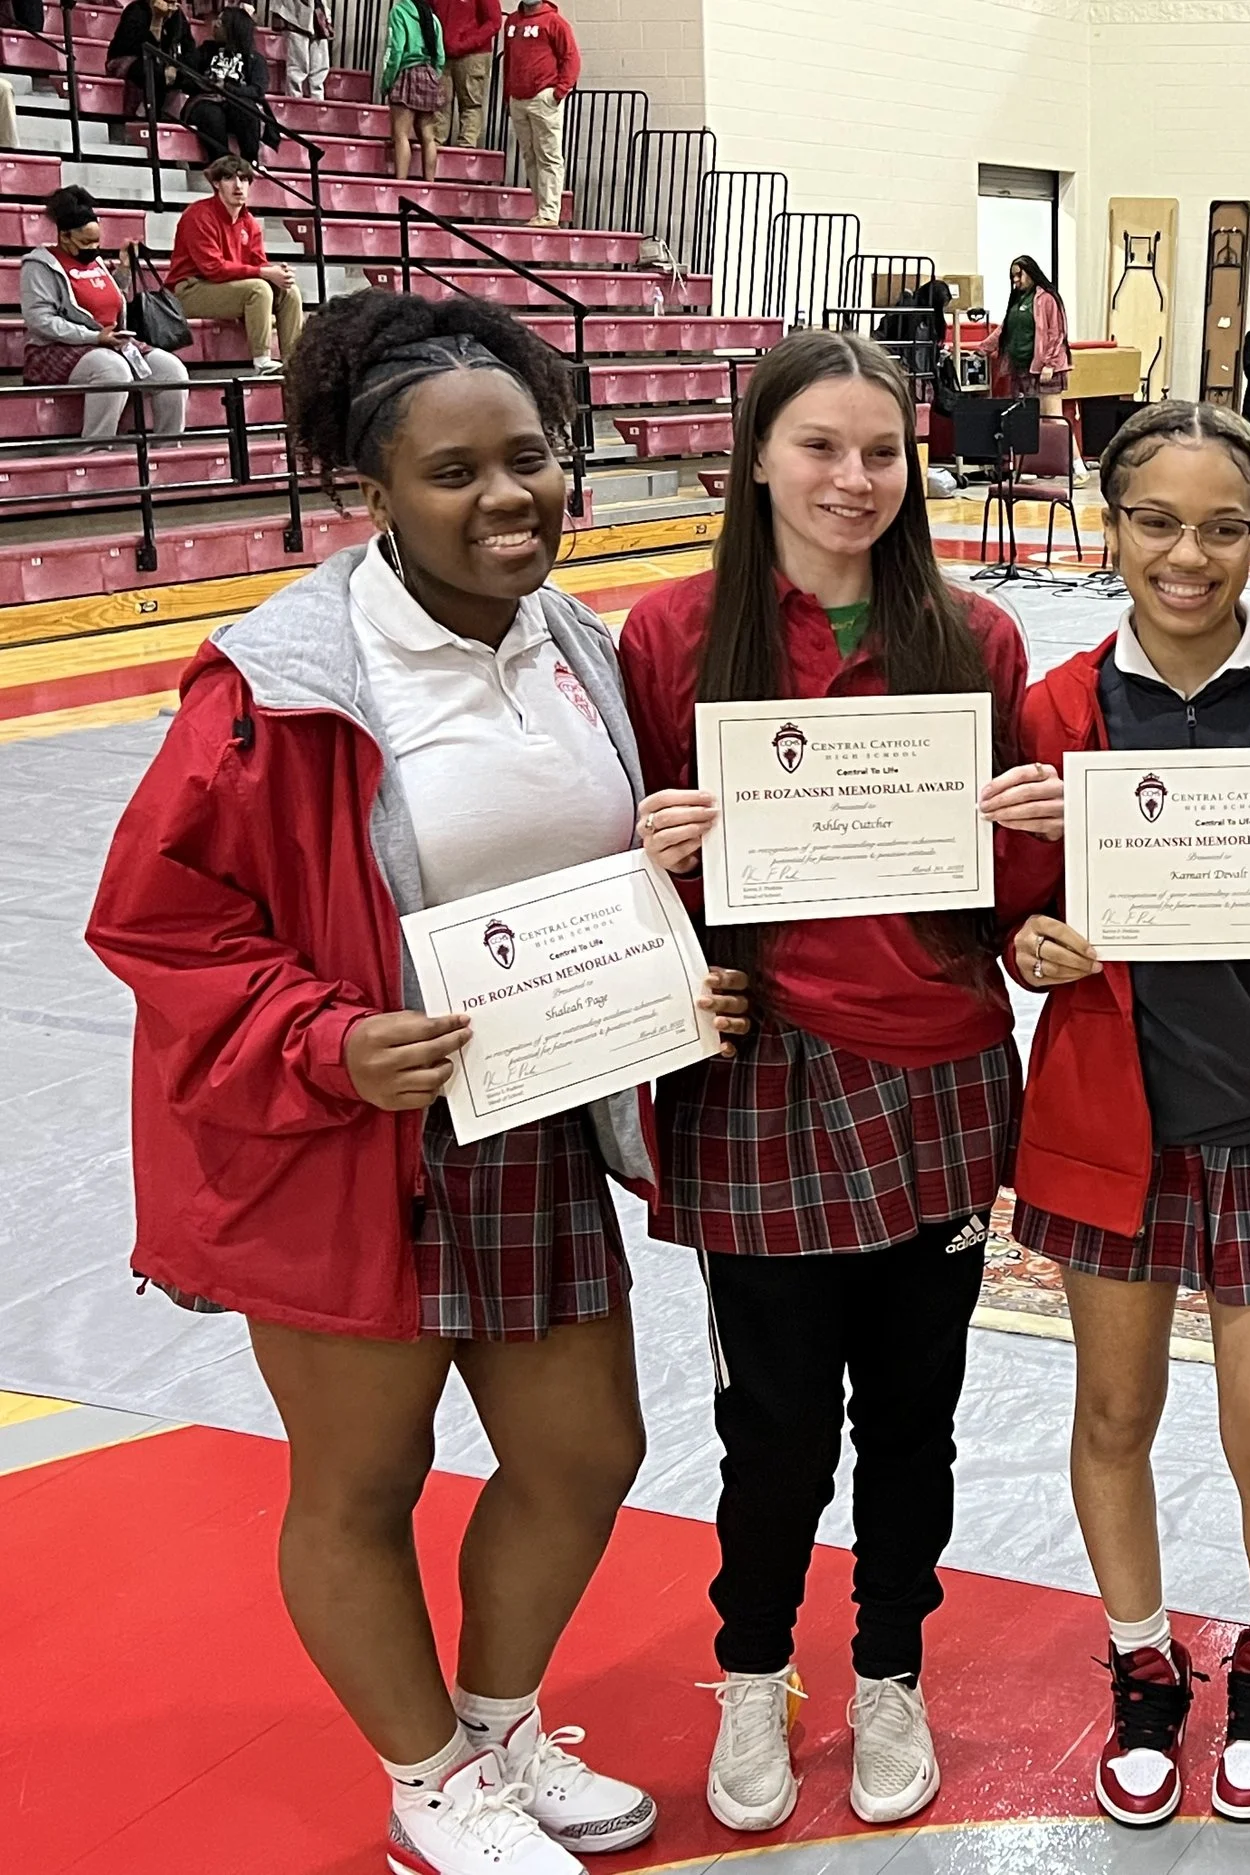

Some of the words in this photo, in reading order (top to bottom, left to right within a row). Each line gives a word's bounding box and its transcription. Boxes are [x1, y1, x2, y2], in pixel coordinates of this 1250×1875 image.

[507, 25, 539, 38] 224
[735, 790, 760, 802] JOE
[763, 786, 833, 799] ROZANSKI
[838, 782, 913, 795] MEMORIAL
[917, 780, 964, 792] AWARD
[812, 818, 848, 836] Ashley
[1099, 838, 1121, 849] JOE
[1125, 836, 1191, 847] ROZANSKI
[579, 942, 588, 951] To
[461, 993, 487, 1011] JOE
[488, 972, 553, 1002] ROZANSKI
[555, 950, 622, 980] MEMORIAL
[623, 936, 665, 958] AWARD
[584, 991, 610, 1011] Page
[945, 1231, 985, 1254] adida
